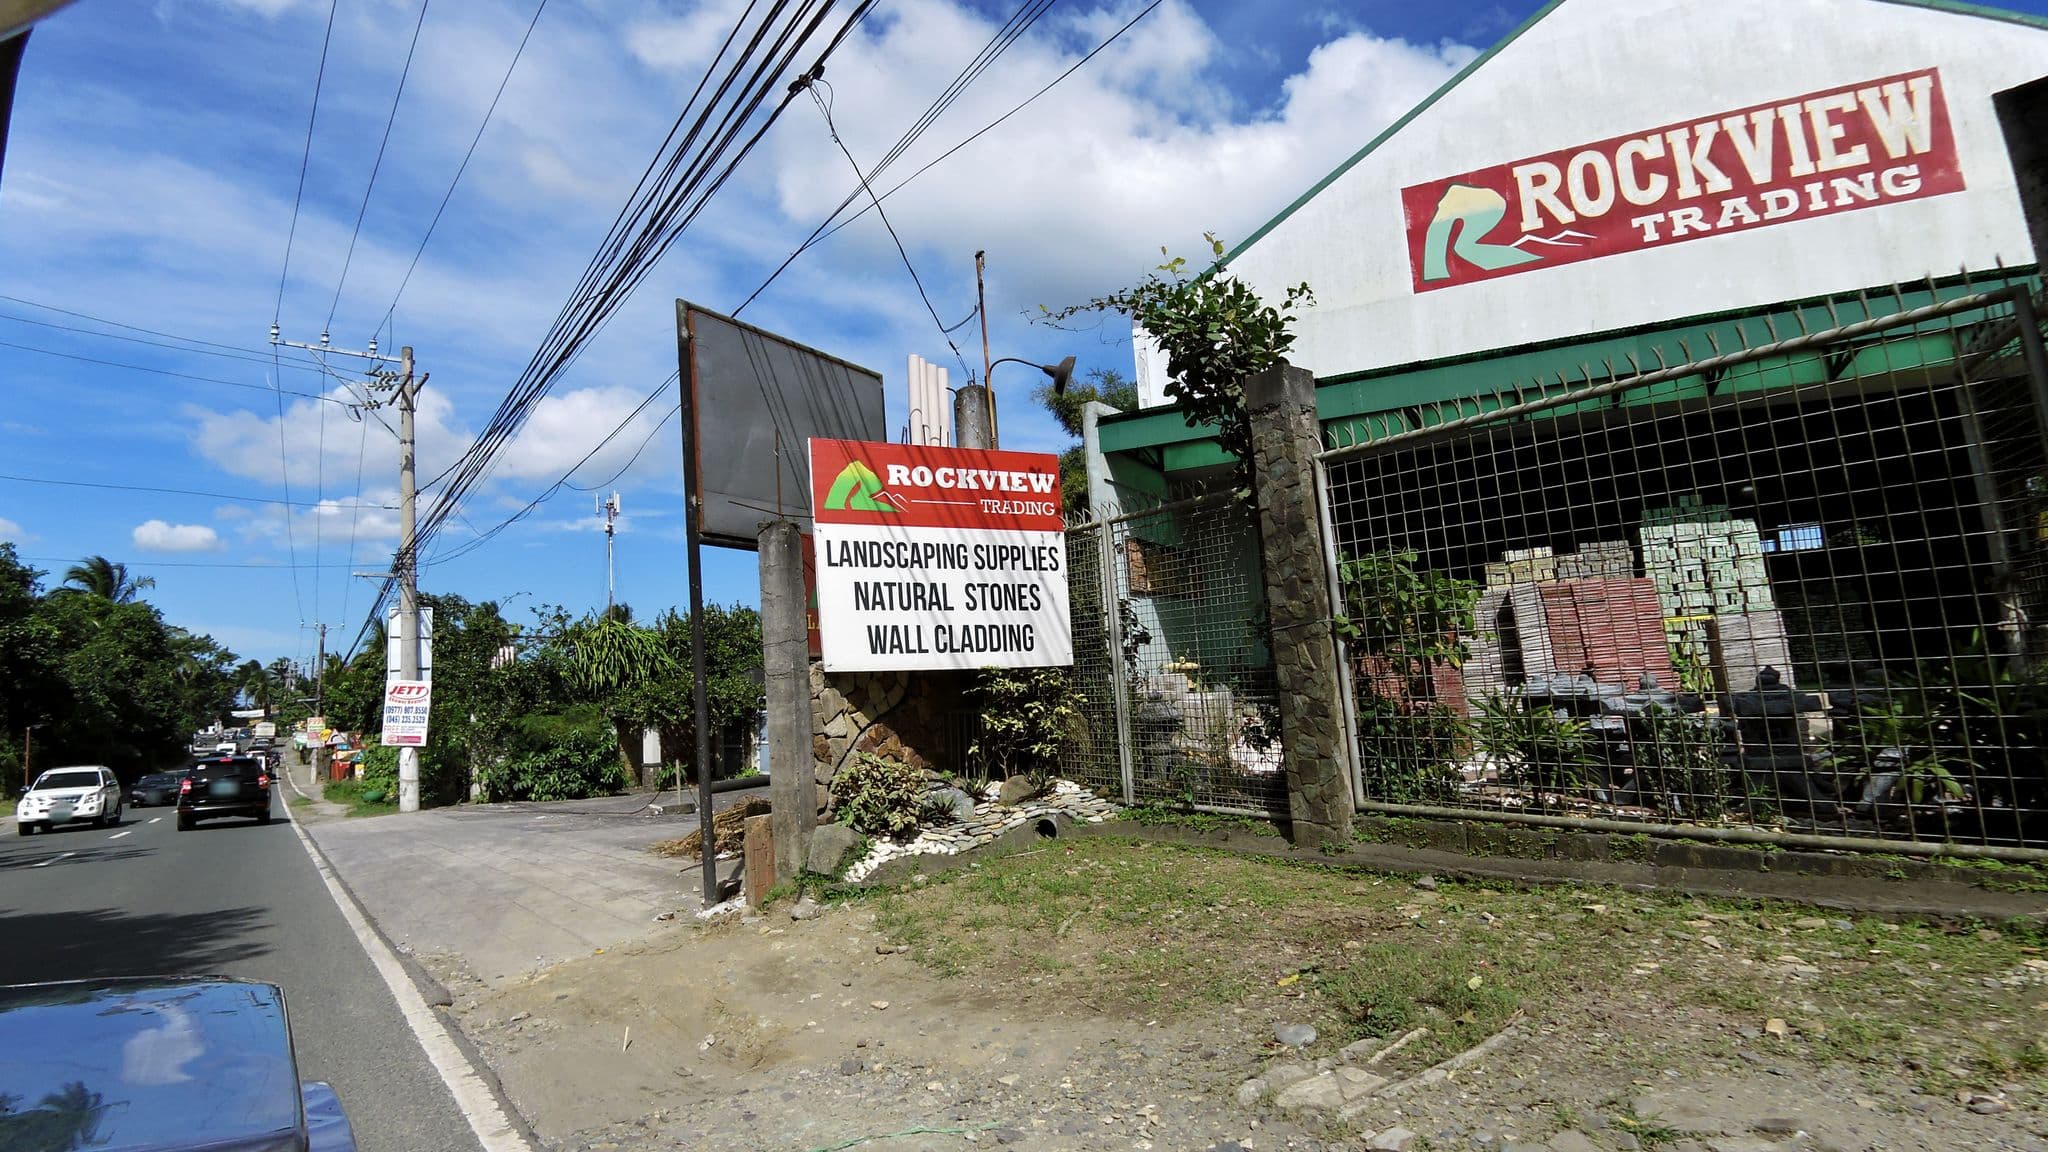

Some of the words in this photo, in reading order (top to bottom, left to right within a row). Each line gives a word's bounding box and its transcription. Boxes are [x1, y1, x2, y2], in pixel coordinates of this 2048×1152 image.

[1512, 75, 1933, 233] ROCKVIEW
[1632, 164, 1922, 243] TRADING
[886, 464, 1056, 494] ROCKVIEW
[980, 498, 1056, 516] TRADING
[825, 540, 968, 570] LANDSCAPING
[974, 544, 1059, 571] SUPPLIES
[853, 581, 955, 611] NATURAL
[964, 582, 1042, 611] STONES
[867, 624, 930, 655] WALL
[934, 623, 1035, 654] CLADDING
[389, 685, 426, 695] JETT
